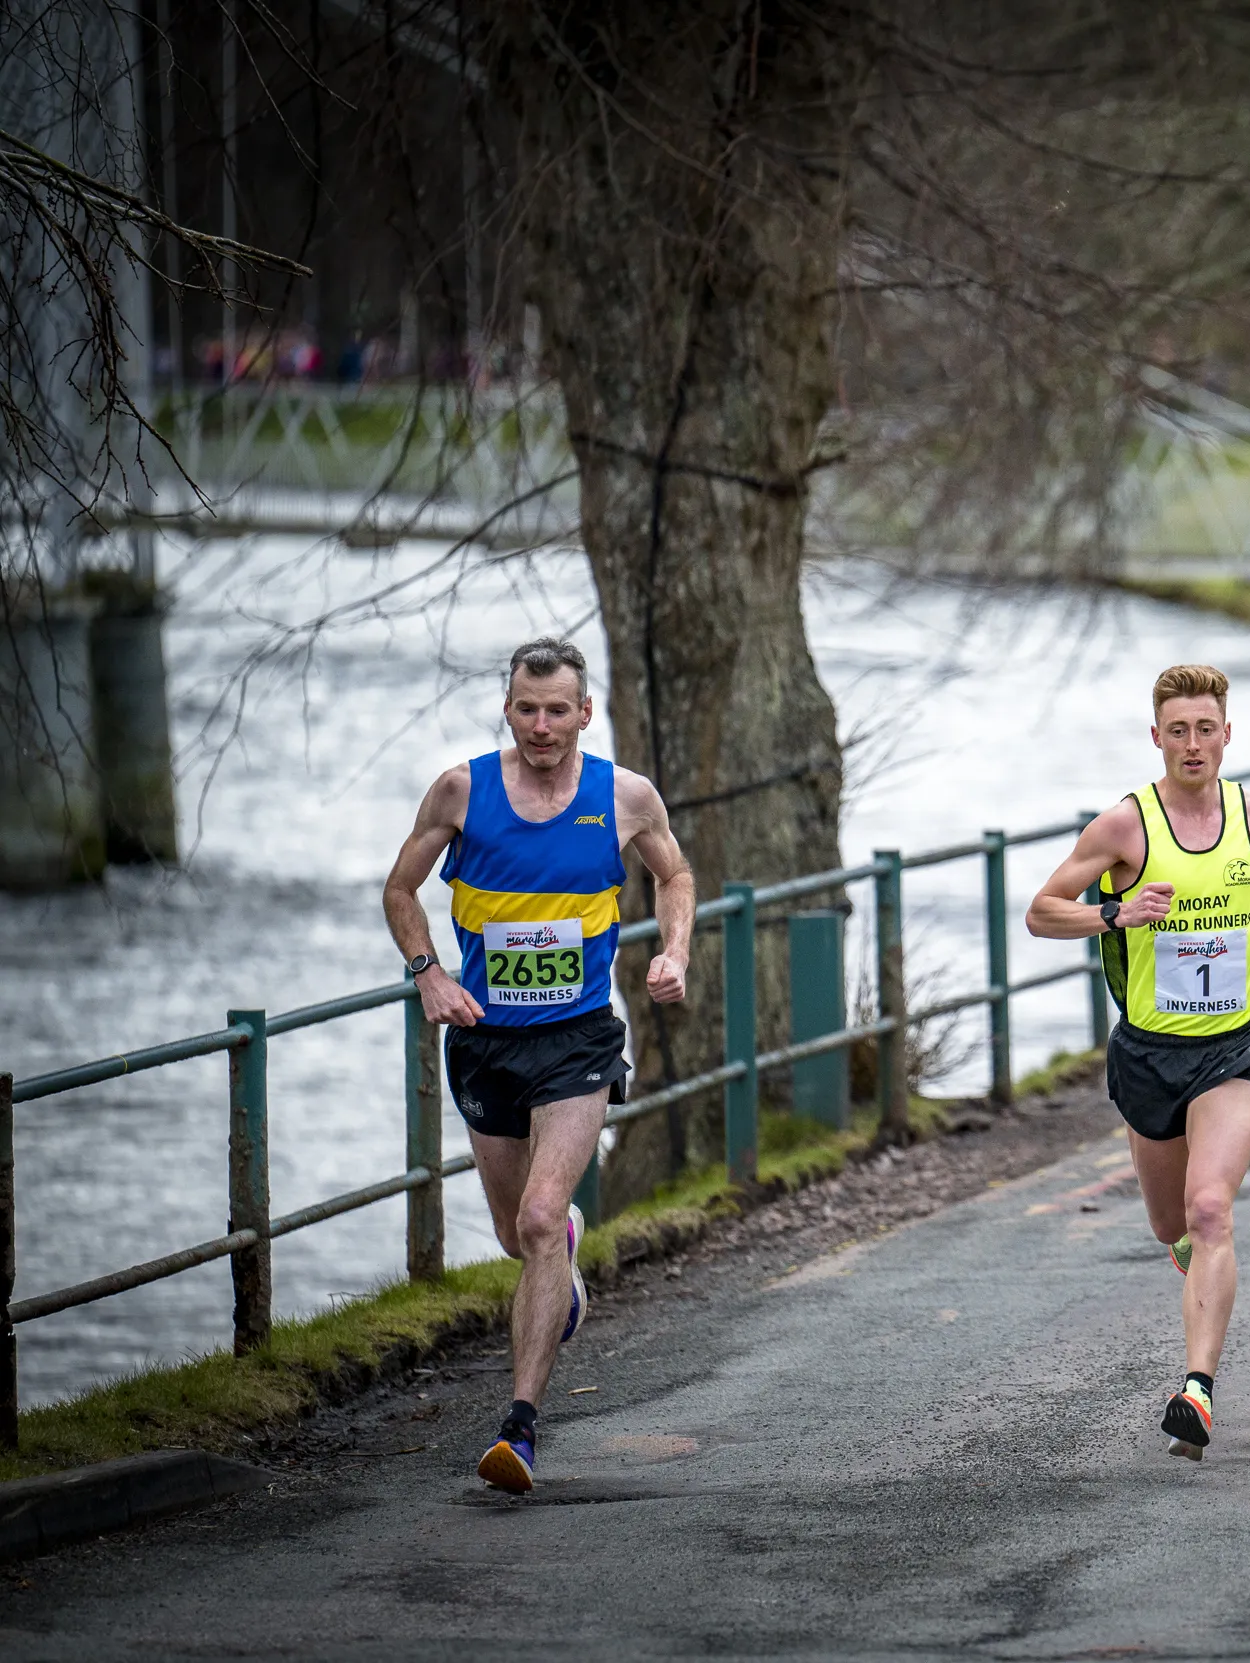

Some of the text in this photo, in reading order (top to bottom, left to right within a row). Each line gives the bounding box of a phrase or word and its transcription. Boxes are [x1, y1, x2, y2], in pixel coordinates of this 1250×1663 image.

[1178, 894, 1230, 912] MORAY
[1149, 919, 1189, 932] ROAD
[506, 930, 558, 948] marathon
[1178, 939, 1227, 957] marathon
[489, 950, 581, 986] 2653
[1196, 963, 1210, 997] 1
[499, 988, 573, 1002] INVERNESS
[1167, 998, 1237, 1012] INVERNESS
